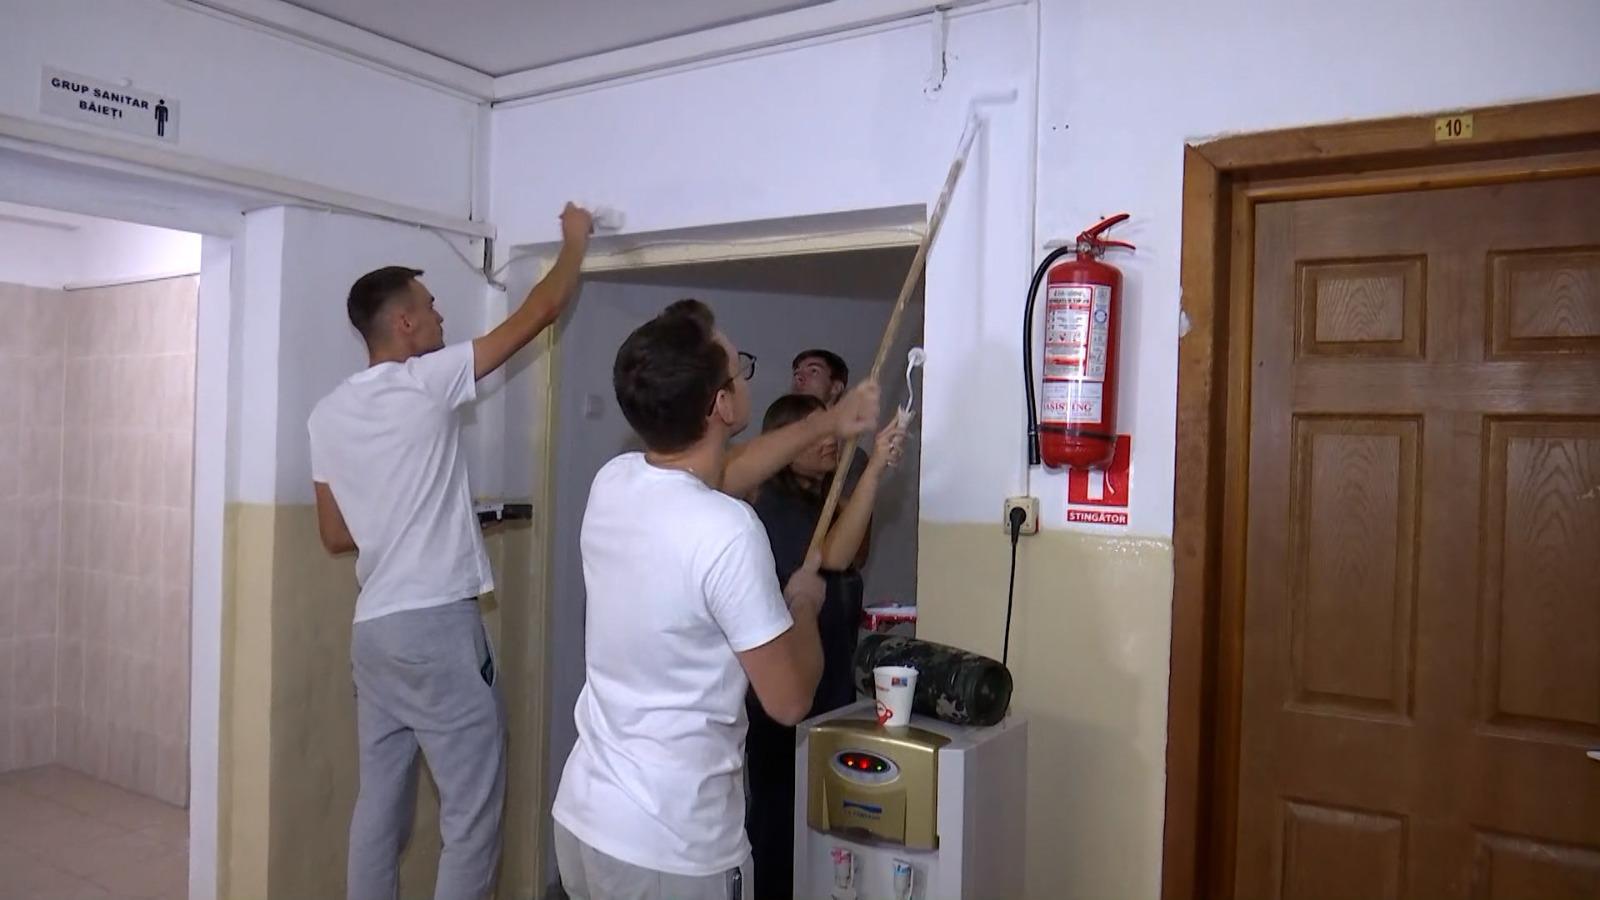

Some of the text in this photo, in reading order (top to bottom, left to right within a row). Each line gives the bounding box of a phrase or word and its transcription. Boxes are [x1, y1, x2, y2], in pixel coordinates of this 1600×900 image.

[51, 77, 149, 110] GRUP SANITAR
[1445, 118, 1462, 137] 10
